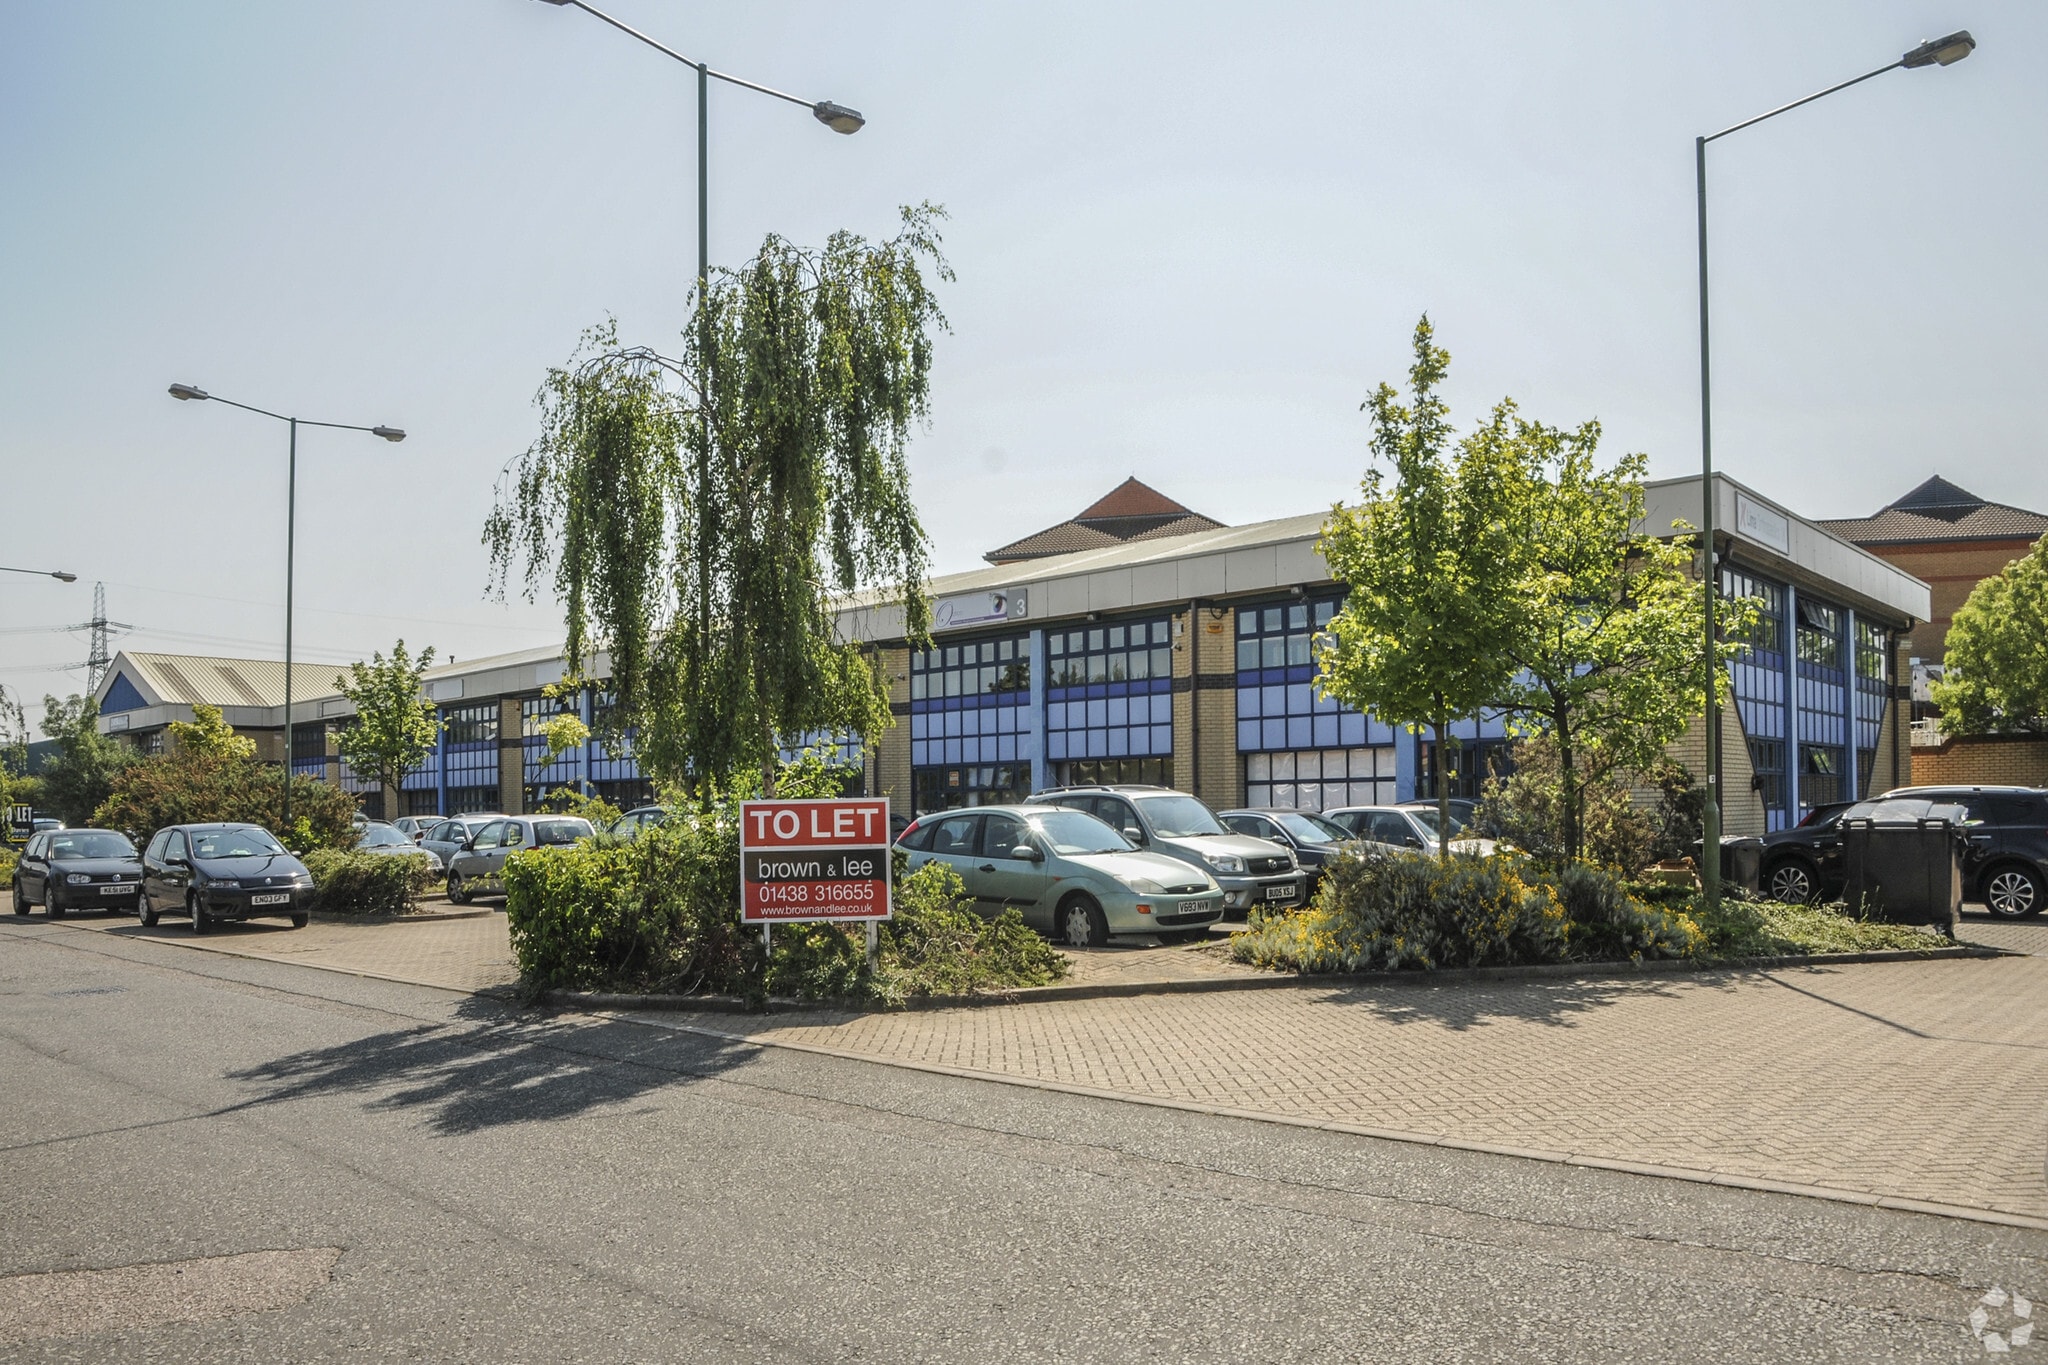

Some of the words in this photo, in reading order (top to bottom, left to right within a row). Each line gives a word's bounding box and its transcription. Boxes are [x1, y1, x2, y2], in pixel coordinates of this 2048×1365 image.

[1017, 599, 1025, 615] 3
[16, 806, 32, 822] LET
[750, 810, 800, 839] TO
[811, 808, 879, 838] LET
[759, 858, 820, 878] brown
[827, 864, 836, 876] &
[843, 856, 873, 876] lee
[760, 885, 808, 902] 01438
[815, 883, 874, 901] 316655
[760, 903, 873, 915] www.brownandlee.co.uk
